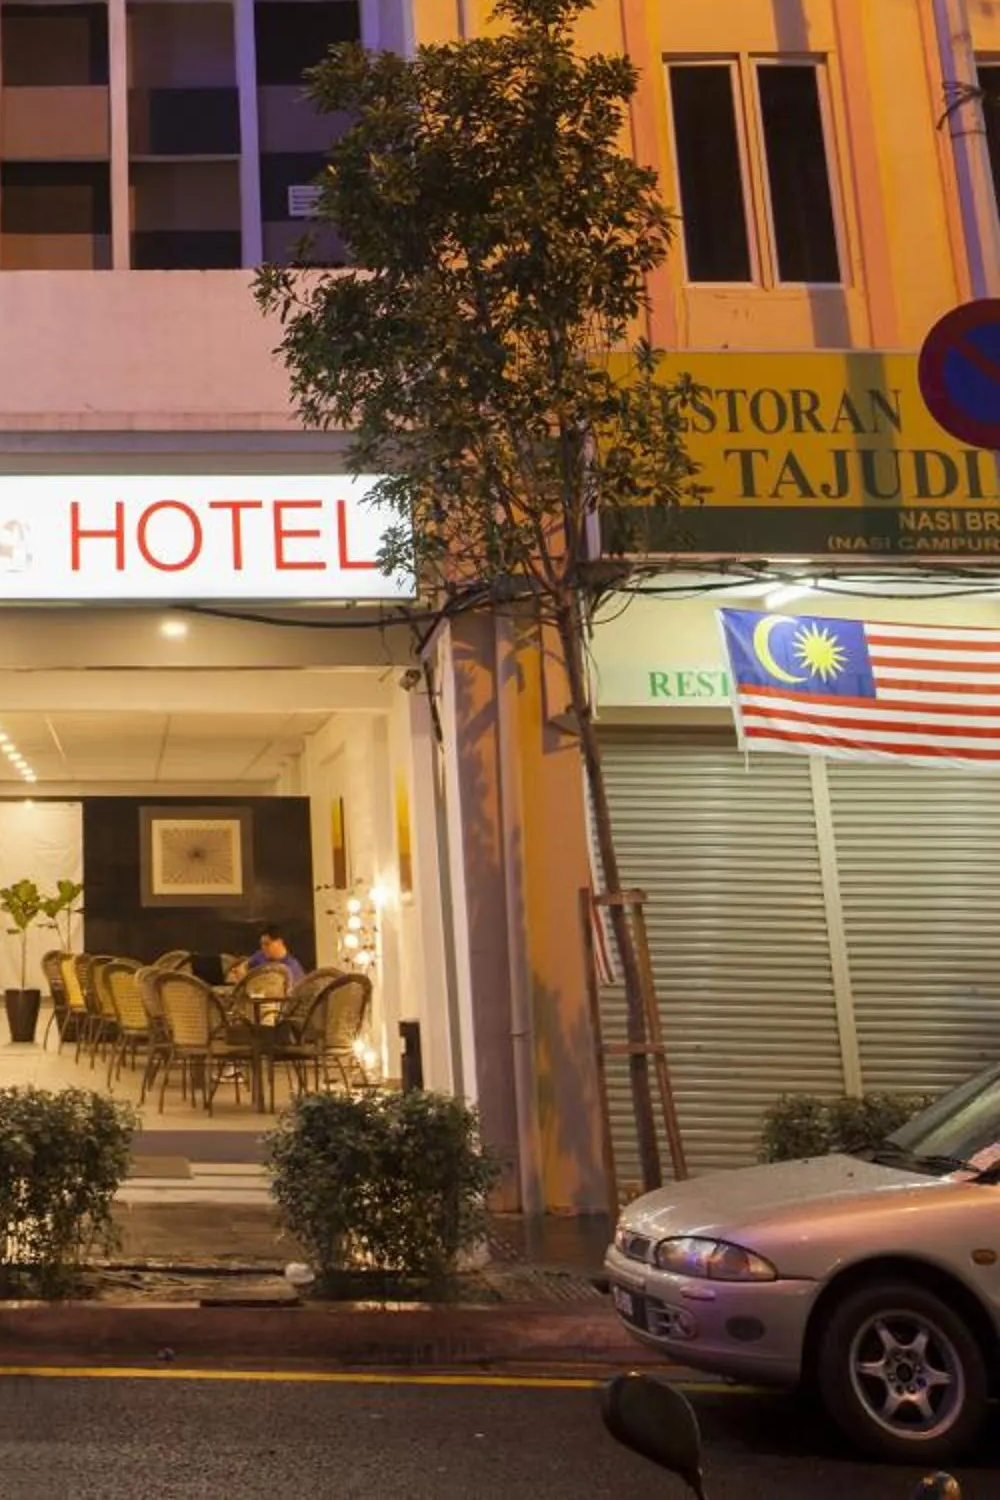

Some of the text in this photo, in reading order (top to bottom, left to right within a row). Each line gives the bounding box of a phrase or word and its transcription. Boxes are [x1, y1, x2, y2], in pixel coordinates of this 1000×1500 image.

[723, 448, 1000, 500] TAJUDI
[69, 499, 379, 572] HOTEL
[899, 510, 957, 531] NASI
